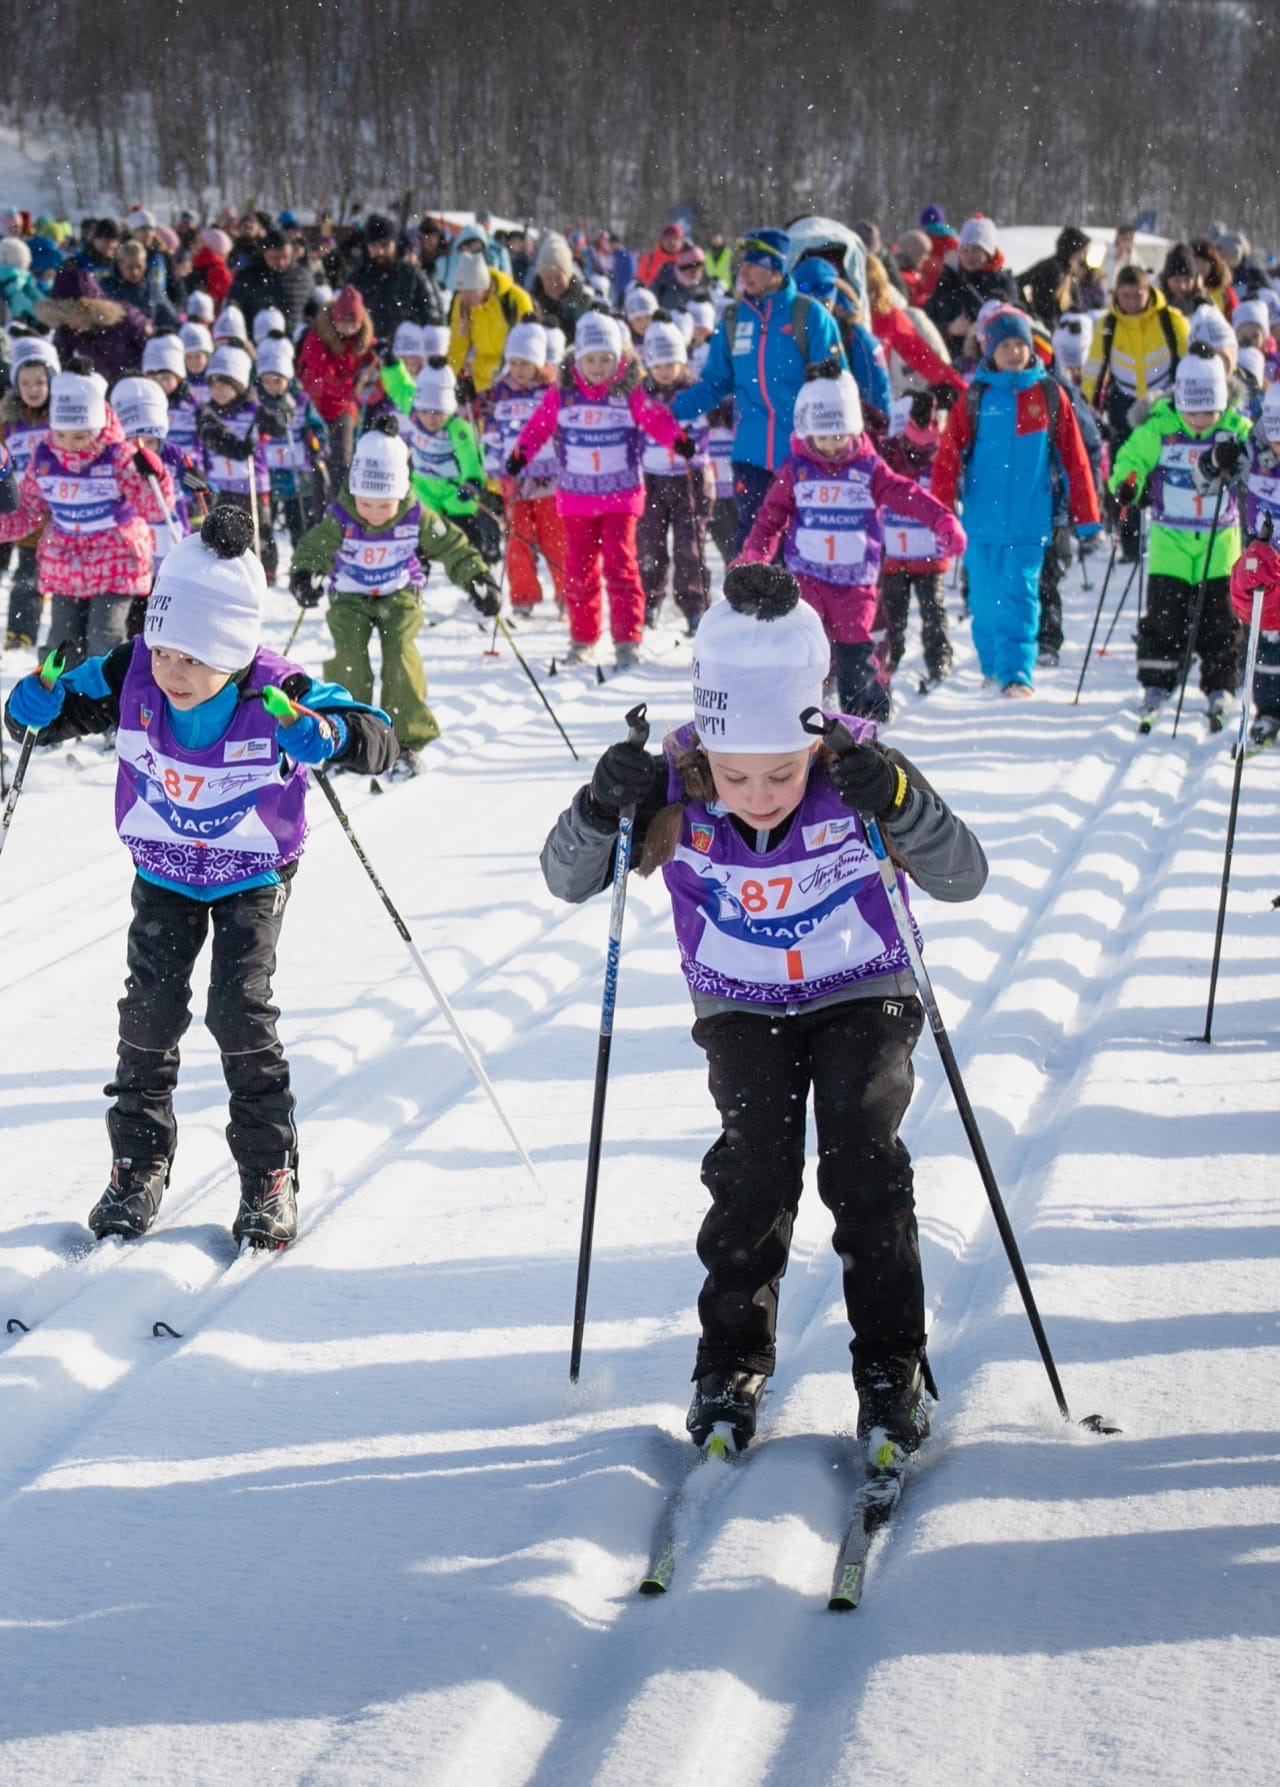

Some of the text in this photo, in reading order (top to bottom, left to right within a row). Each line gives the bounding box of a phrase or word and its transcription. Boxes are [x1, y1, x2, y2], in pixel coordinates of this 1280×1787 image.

[583, 410, 603, 425] 87
[591, 450, 600, 472] 1
[58, 482, 80, 501] 87
[819, 485, 841, 503] 87
[1192, 494, 1203, 517] 1
[824, 535, 835, 562] 1
[897, 531, 908, 553] 1
[363, 547, 388, 565] 87
[164, 768, 205, 803] 87
[741, 876, 794, 913] 87
[601, 935, 620, 1031] NORDWAY
